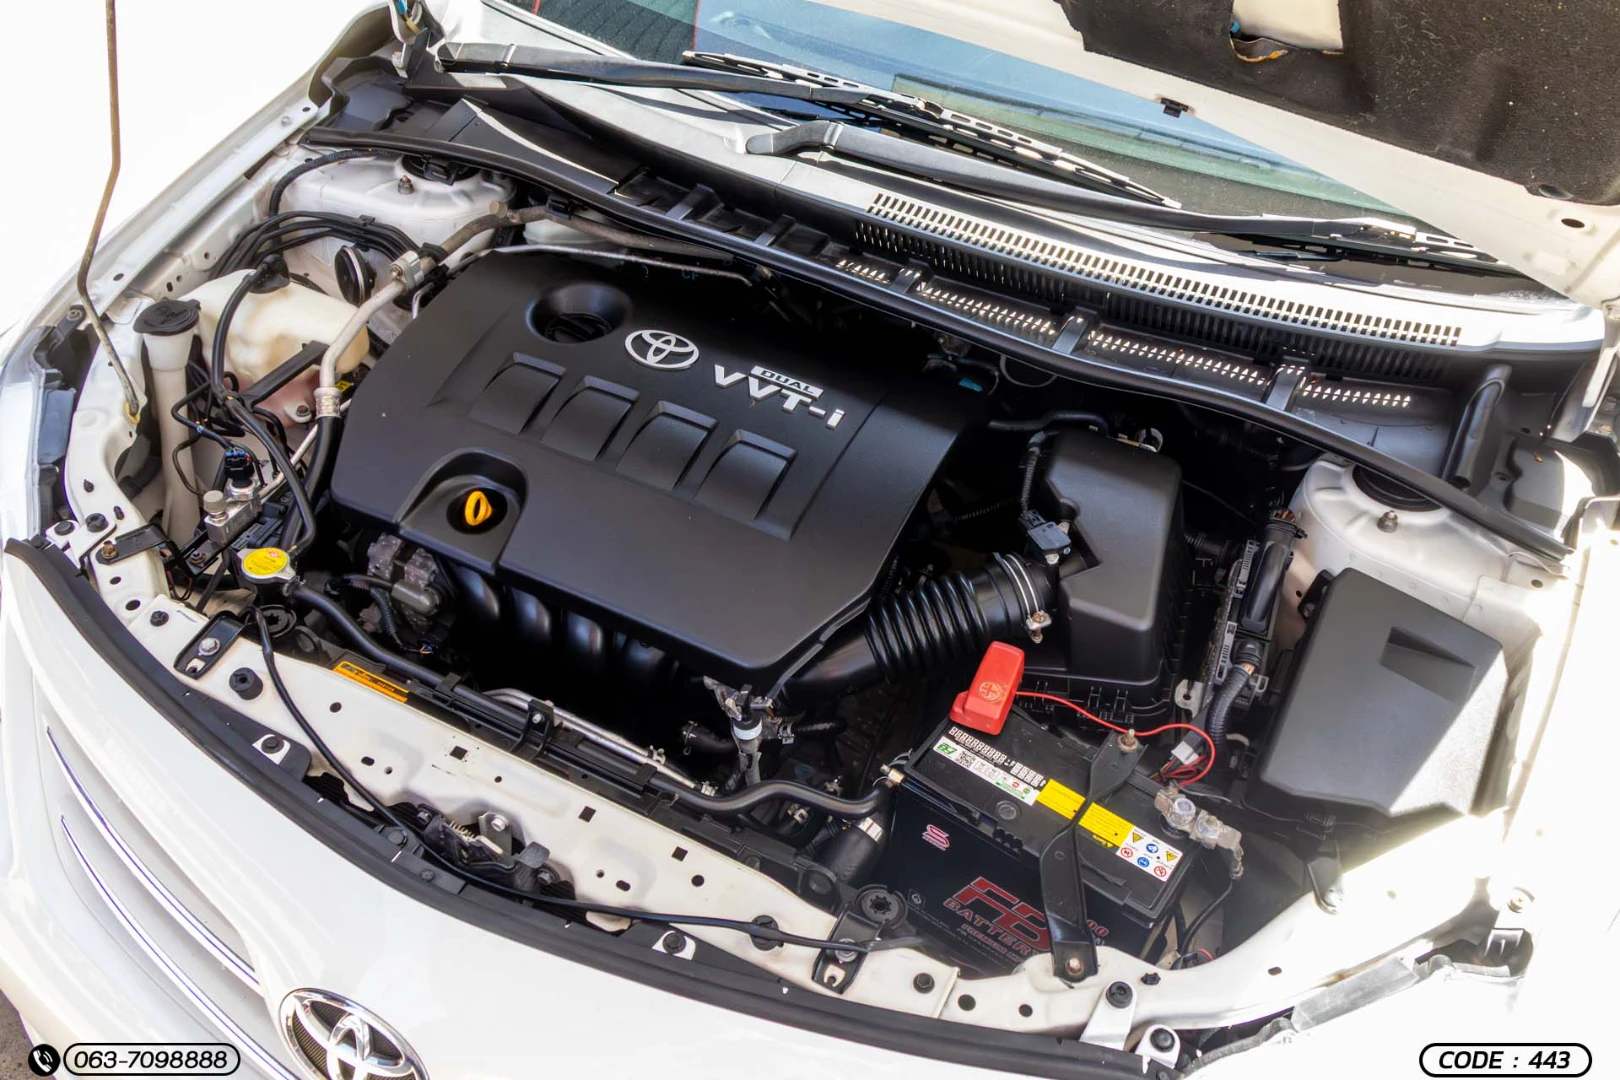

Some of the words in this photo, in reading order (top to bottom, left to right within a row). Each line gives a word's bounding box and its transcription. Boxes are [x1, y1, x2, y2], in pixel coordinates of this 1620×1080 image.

[714, 364, 846, 430] VVT-i
[758, 369, 814, 394] DUAL
[952, 876, 1052, 951] FB
